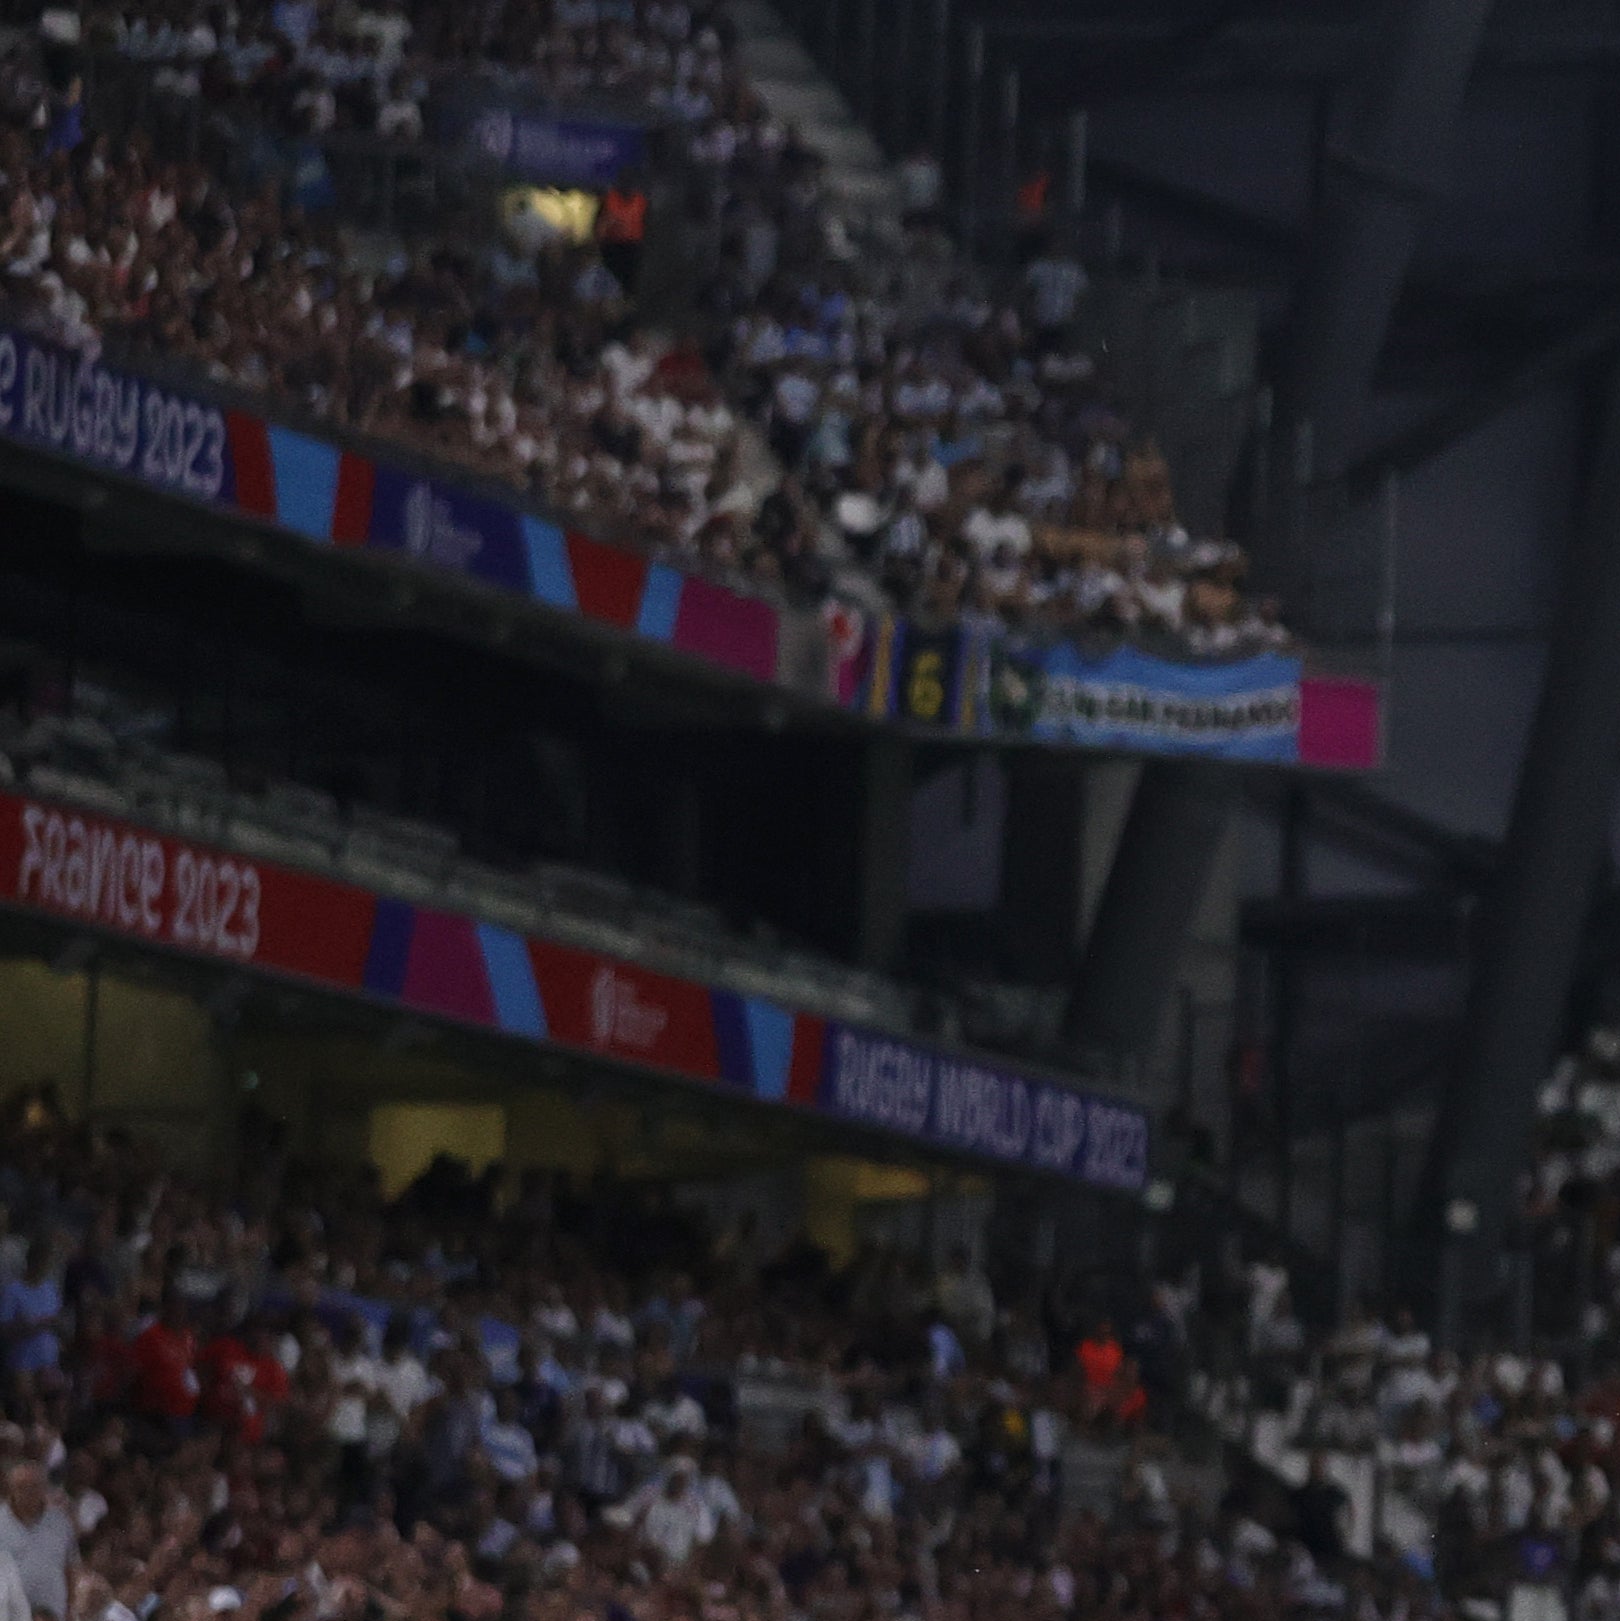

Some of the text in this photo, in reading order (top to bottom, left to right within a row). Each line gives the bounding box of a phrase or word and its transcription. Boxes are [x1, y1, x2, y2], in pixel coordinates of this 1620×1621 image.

[25, 348, 139, 468] RUGBY
[143, 388, 224, 500] 2023
[174, 852, 261, 956] 2023
